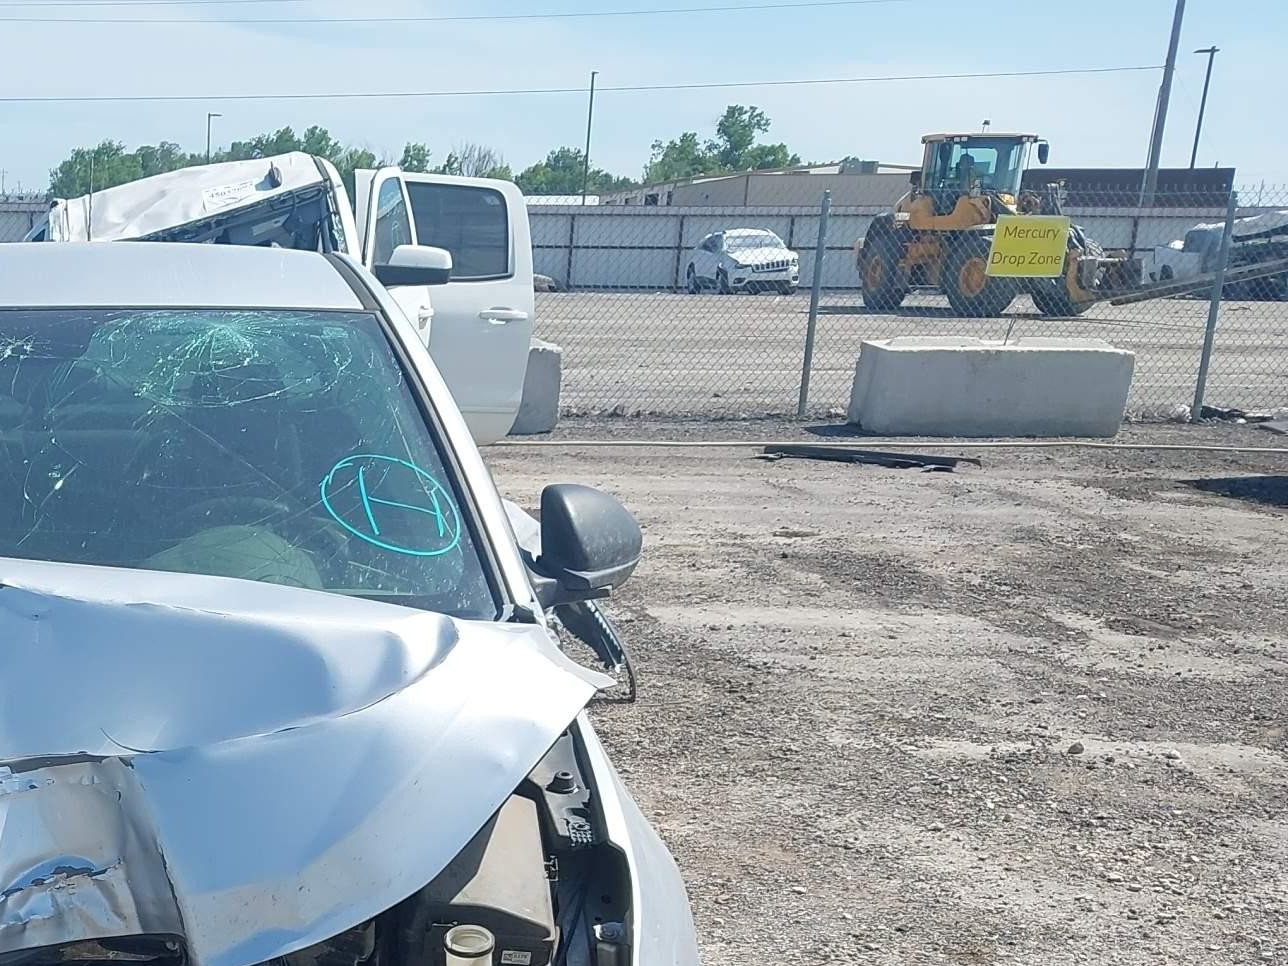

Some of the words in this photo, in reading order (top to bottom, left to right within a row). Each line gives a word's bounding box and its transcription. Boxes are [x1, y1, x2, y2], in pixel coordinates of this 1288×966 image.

[1003, 225, 1061, 241] Mercury
[991, 251, 1026, 268] Drop
[1028, 251, 1062, 266] Zone
